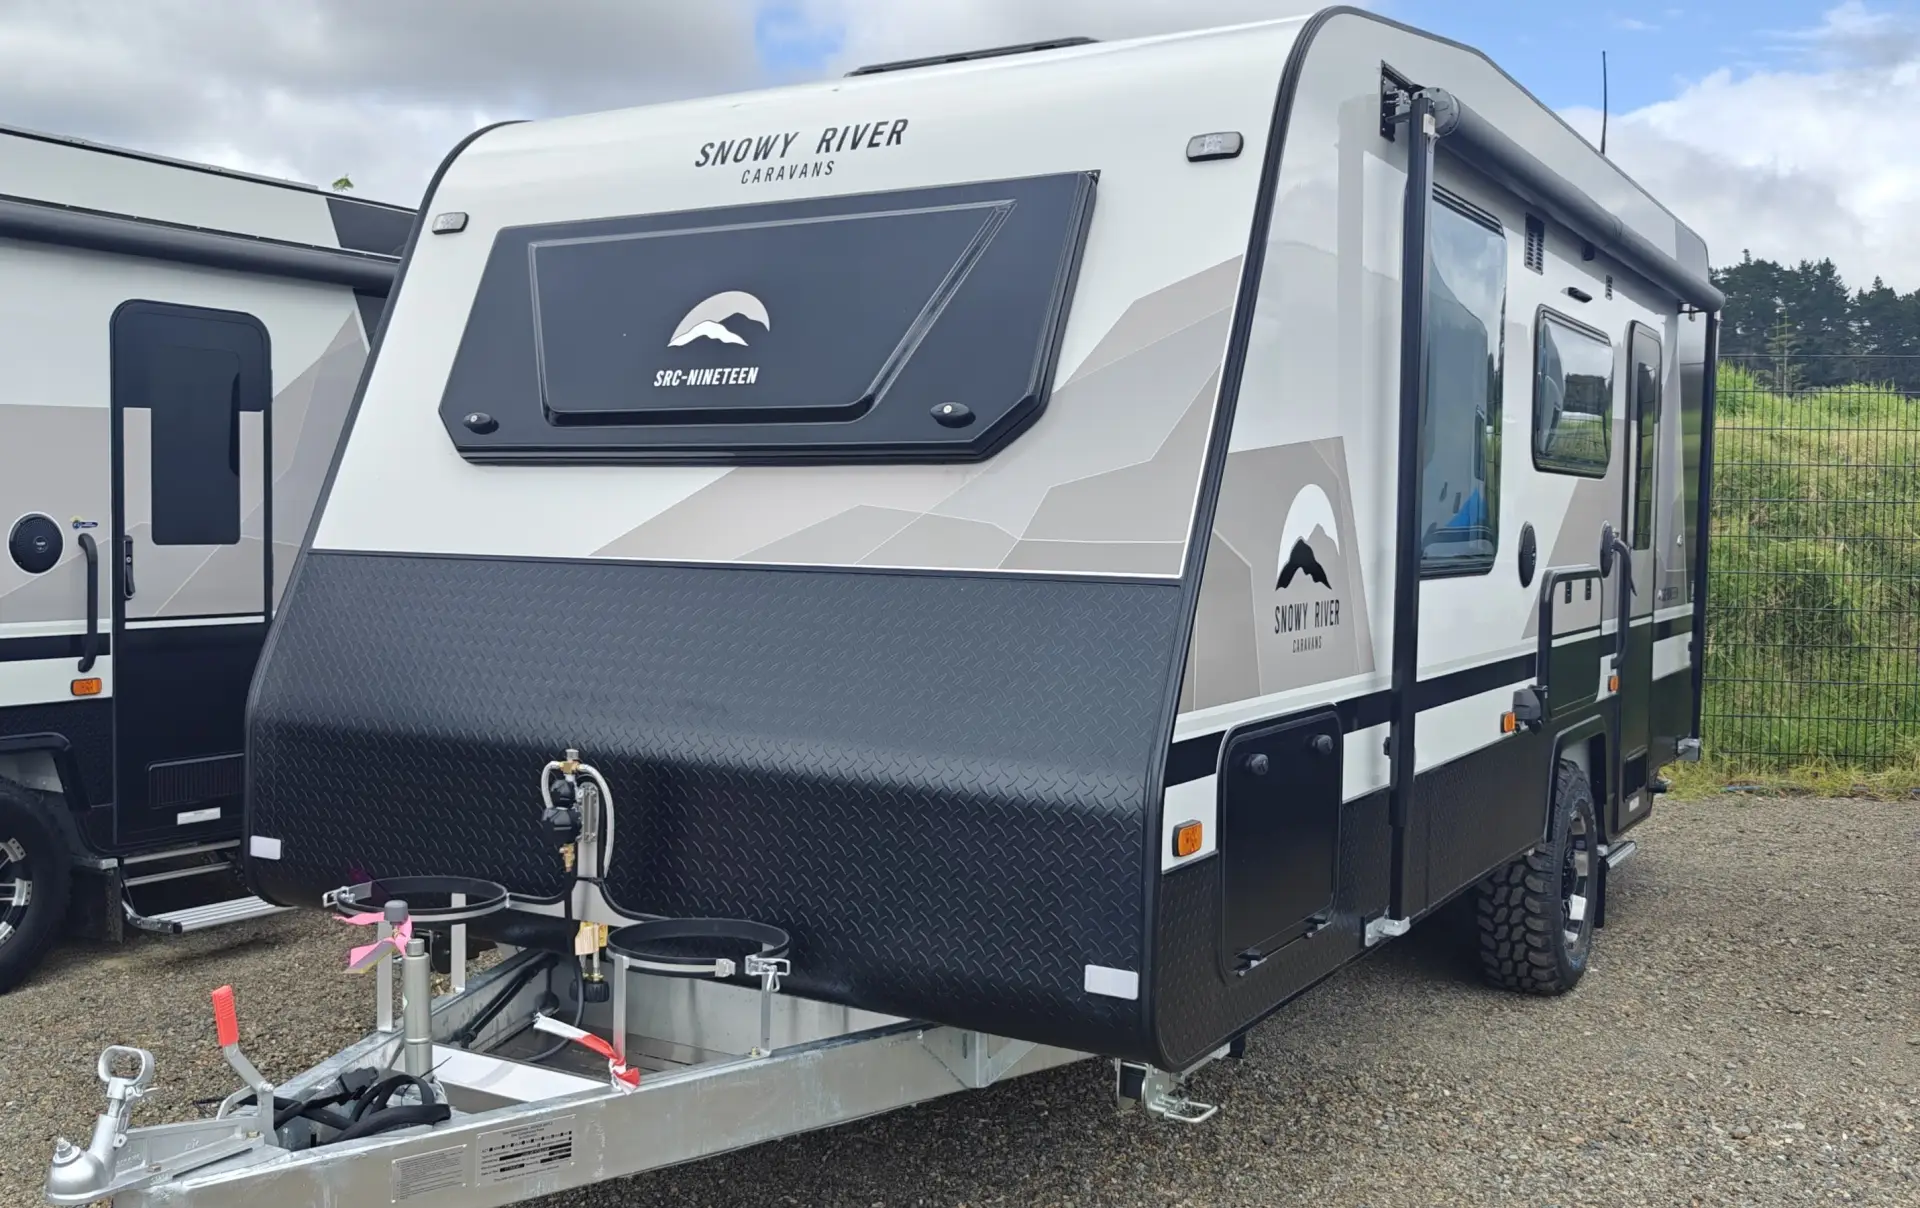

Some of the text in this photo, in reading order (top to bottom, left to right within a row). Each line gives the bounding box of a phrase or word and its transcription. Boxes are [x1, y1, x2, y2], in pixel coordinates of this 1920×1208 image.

[694, 118, 909, 168] SNOWY RIVER
[740, 160, 835, 185] CARAVANS
[653, 367, 759, 387] SRC-NINETEEN
[1274, 599, 1340, 634] SNOWY RIVER
[1292, 635, 1322, 654] CARAVANS
